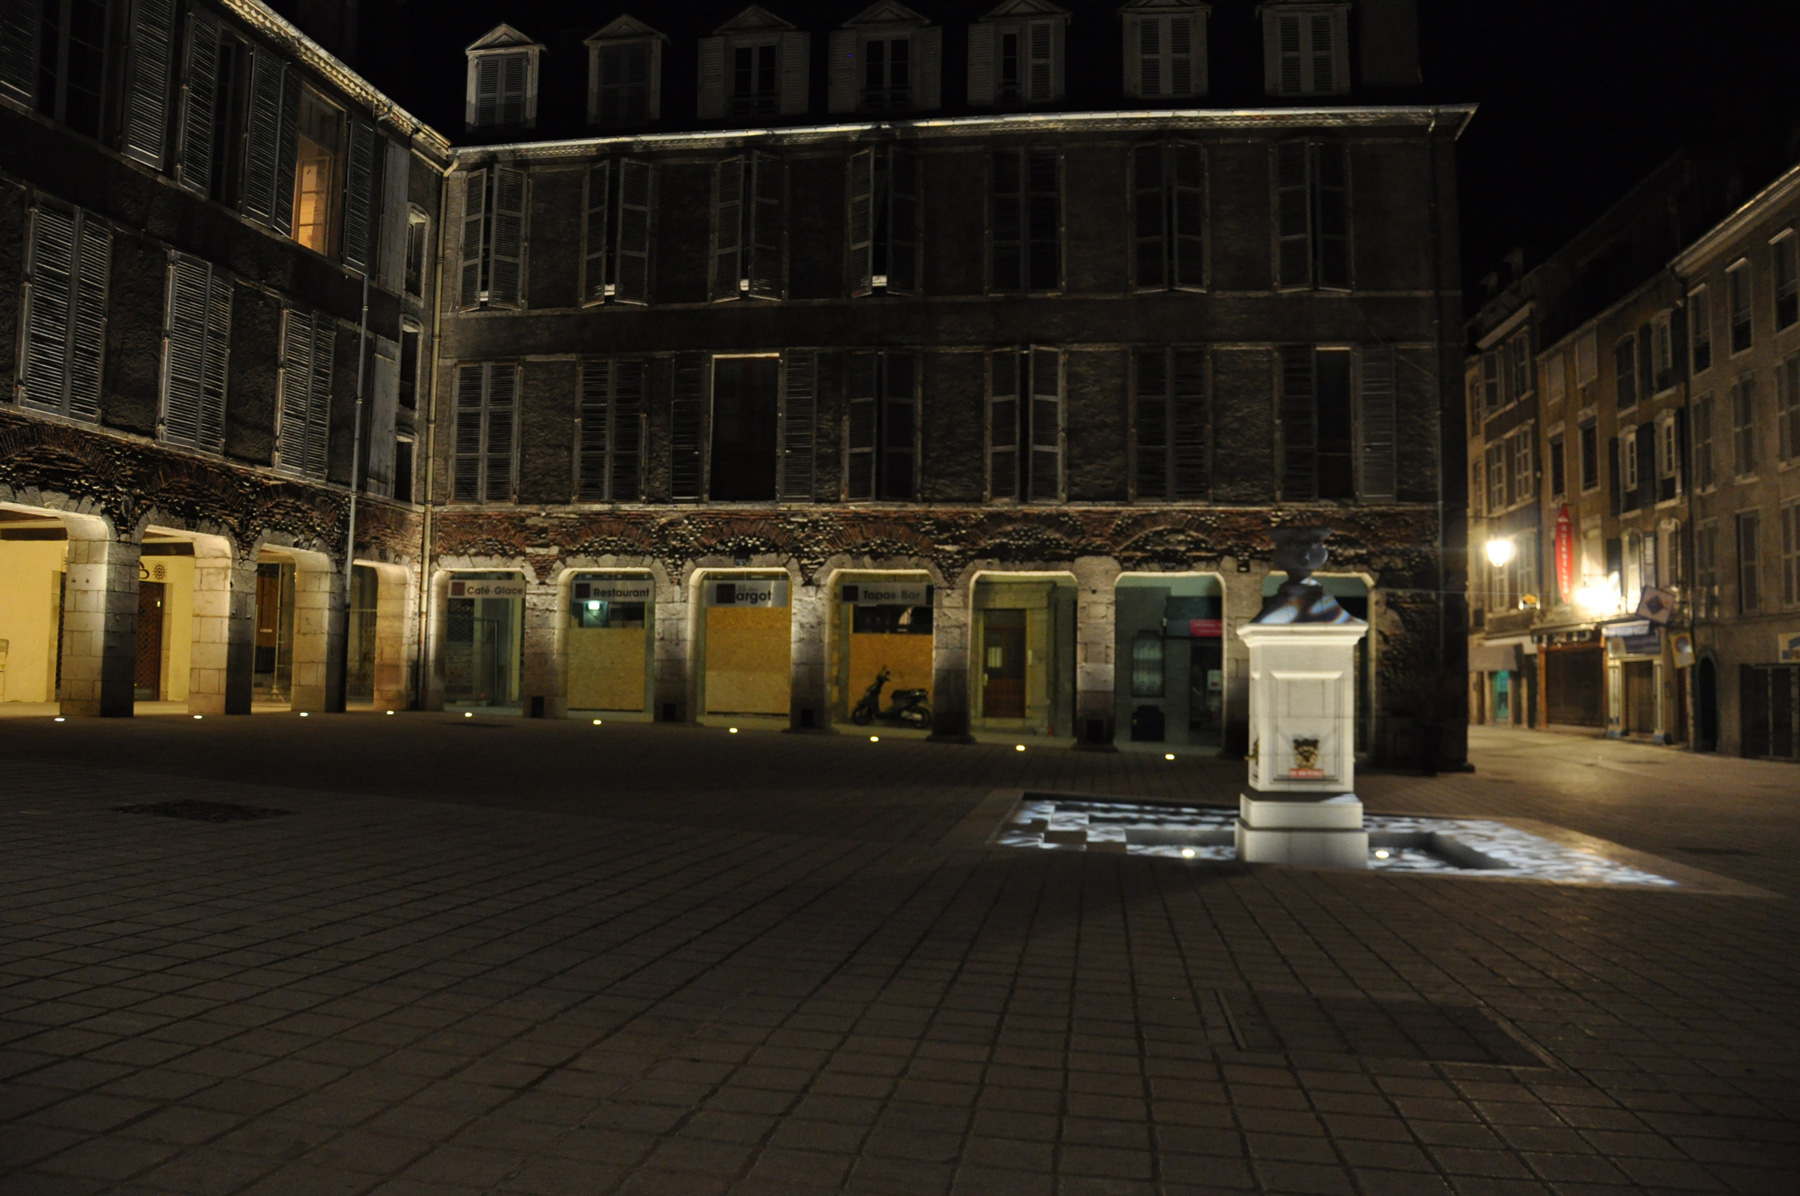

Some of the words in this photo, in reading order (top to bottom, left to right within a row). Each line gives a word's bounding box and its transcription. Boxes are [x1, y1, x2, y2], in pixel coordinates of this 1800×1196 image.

[466, 585, 490, 595] Café
[494, 586, 523, 595] Glace
[593, 588, 650, 597] Restaurant
[863, 590, 896, 601] Tapas
[901, 590, 921, 599] Bar
